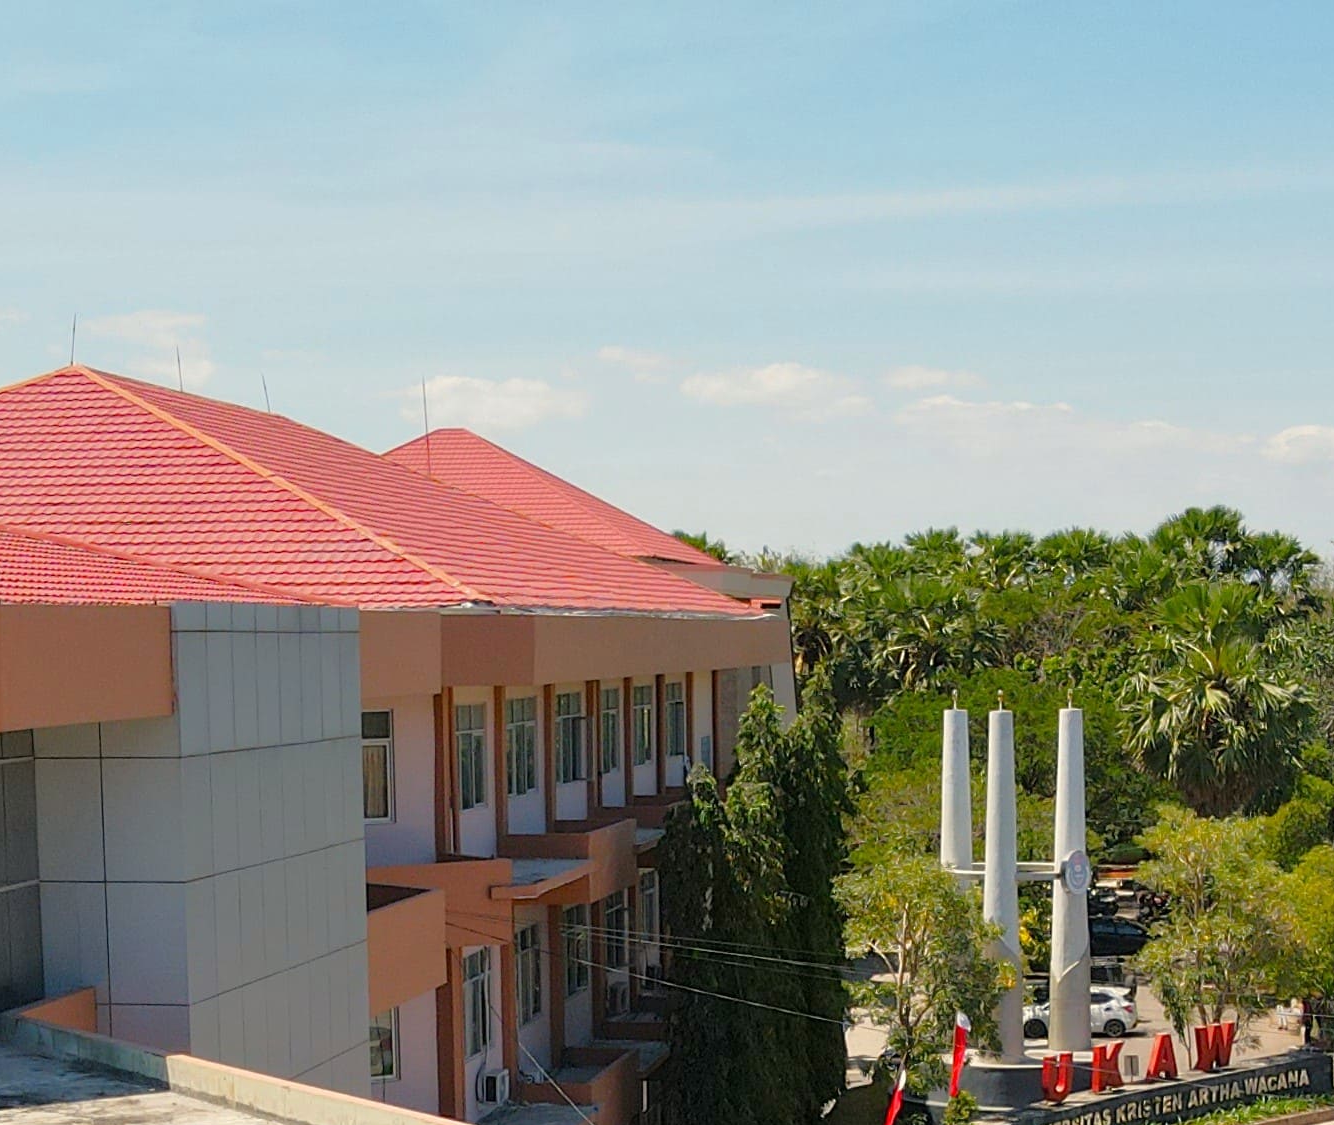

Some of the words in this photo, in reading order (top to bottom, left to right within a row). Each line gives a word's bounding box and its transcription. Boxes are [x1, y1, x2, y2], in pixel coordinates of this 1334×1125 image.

[1042, 1020, 1235, 1103] UKAW
[1116, 1092, 1182, 1125] KRISTEN
[1188, 1081, 1241, 1109] ARTHA
[1244, 1068, 1310, 1095] WACANA
